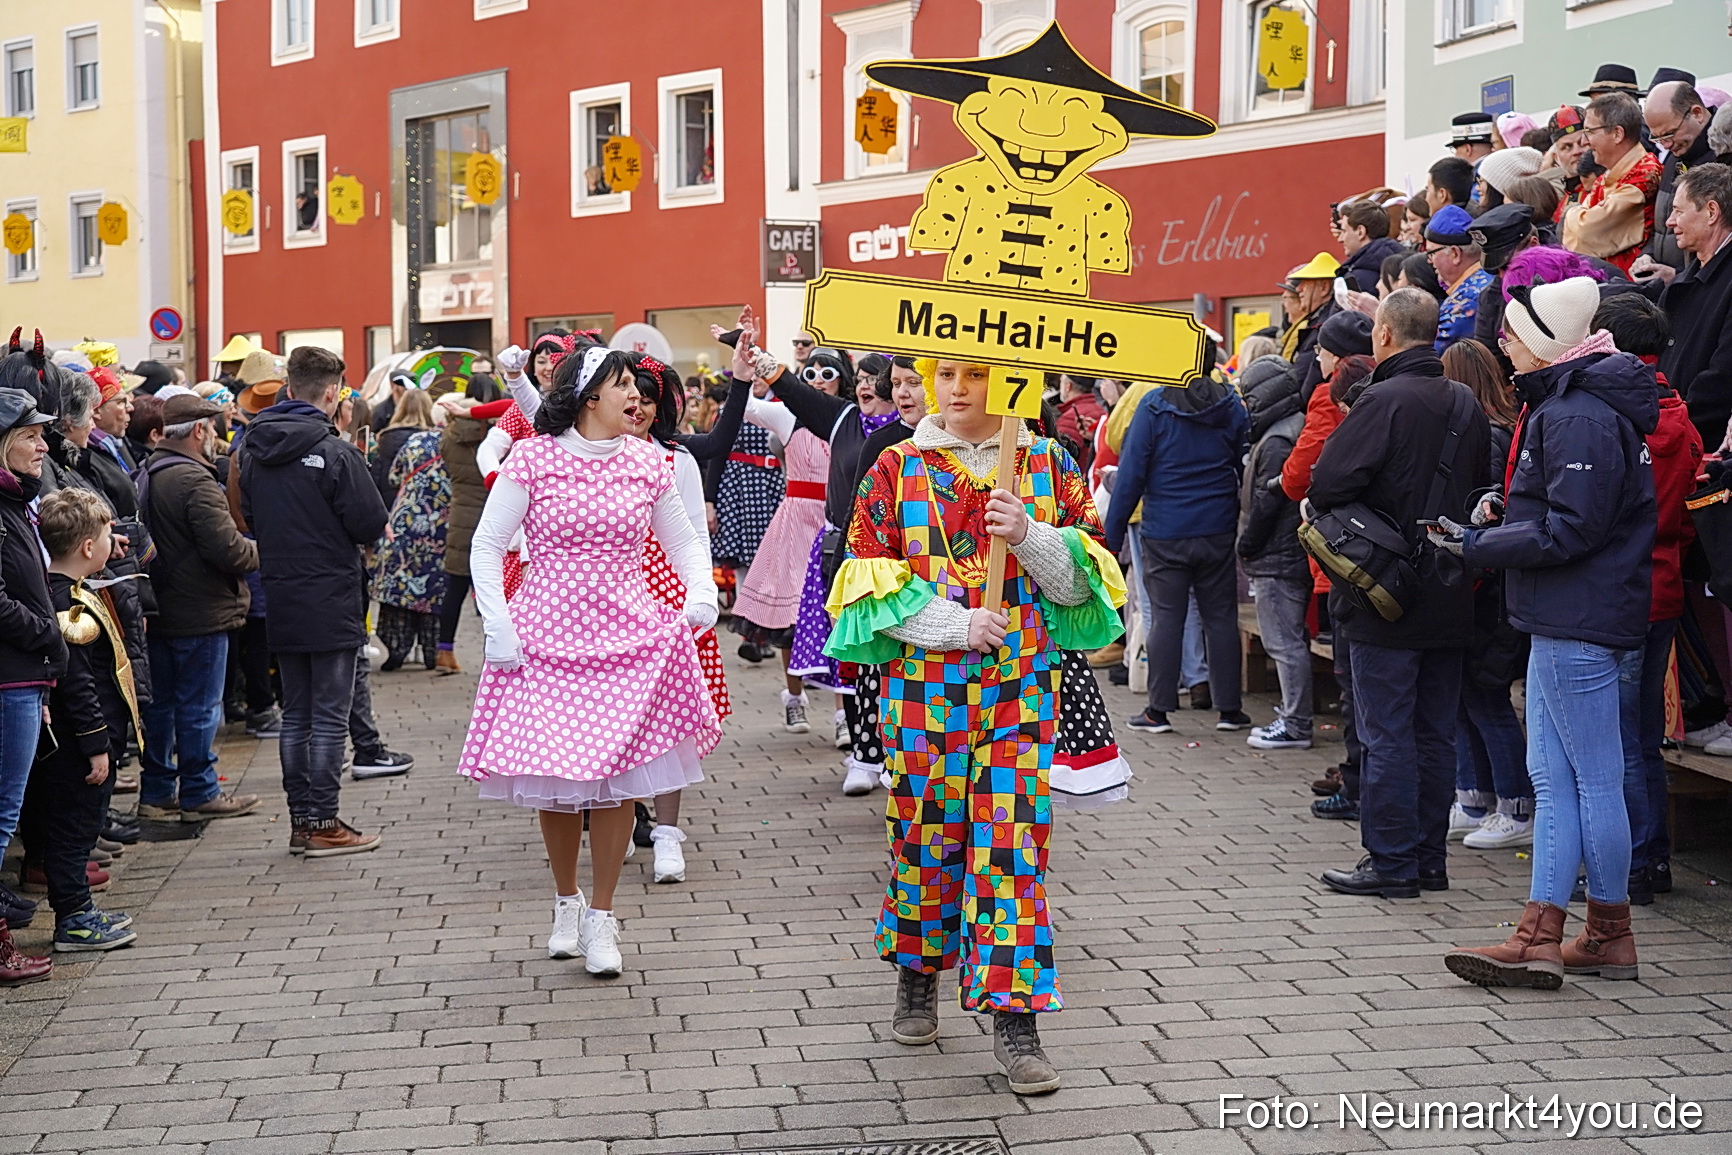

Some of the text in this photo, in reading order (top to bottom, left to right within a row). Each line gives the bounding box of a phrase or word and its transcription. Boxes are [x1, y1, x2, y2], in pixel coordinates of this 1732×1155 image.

[769, 227, 813, 251] CAFÉ
[848, 224, 946, 263] GÖT
[1157, 191, 1268, 266] Erlebnis
[897, 299, 1118, 358] Ma-Hai-He
[1005, 376, 1028, 410] 7
